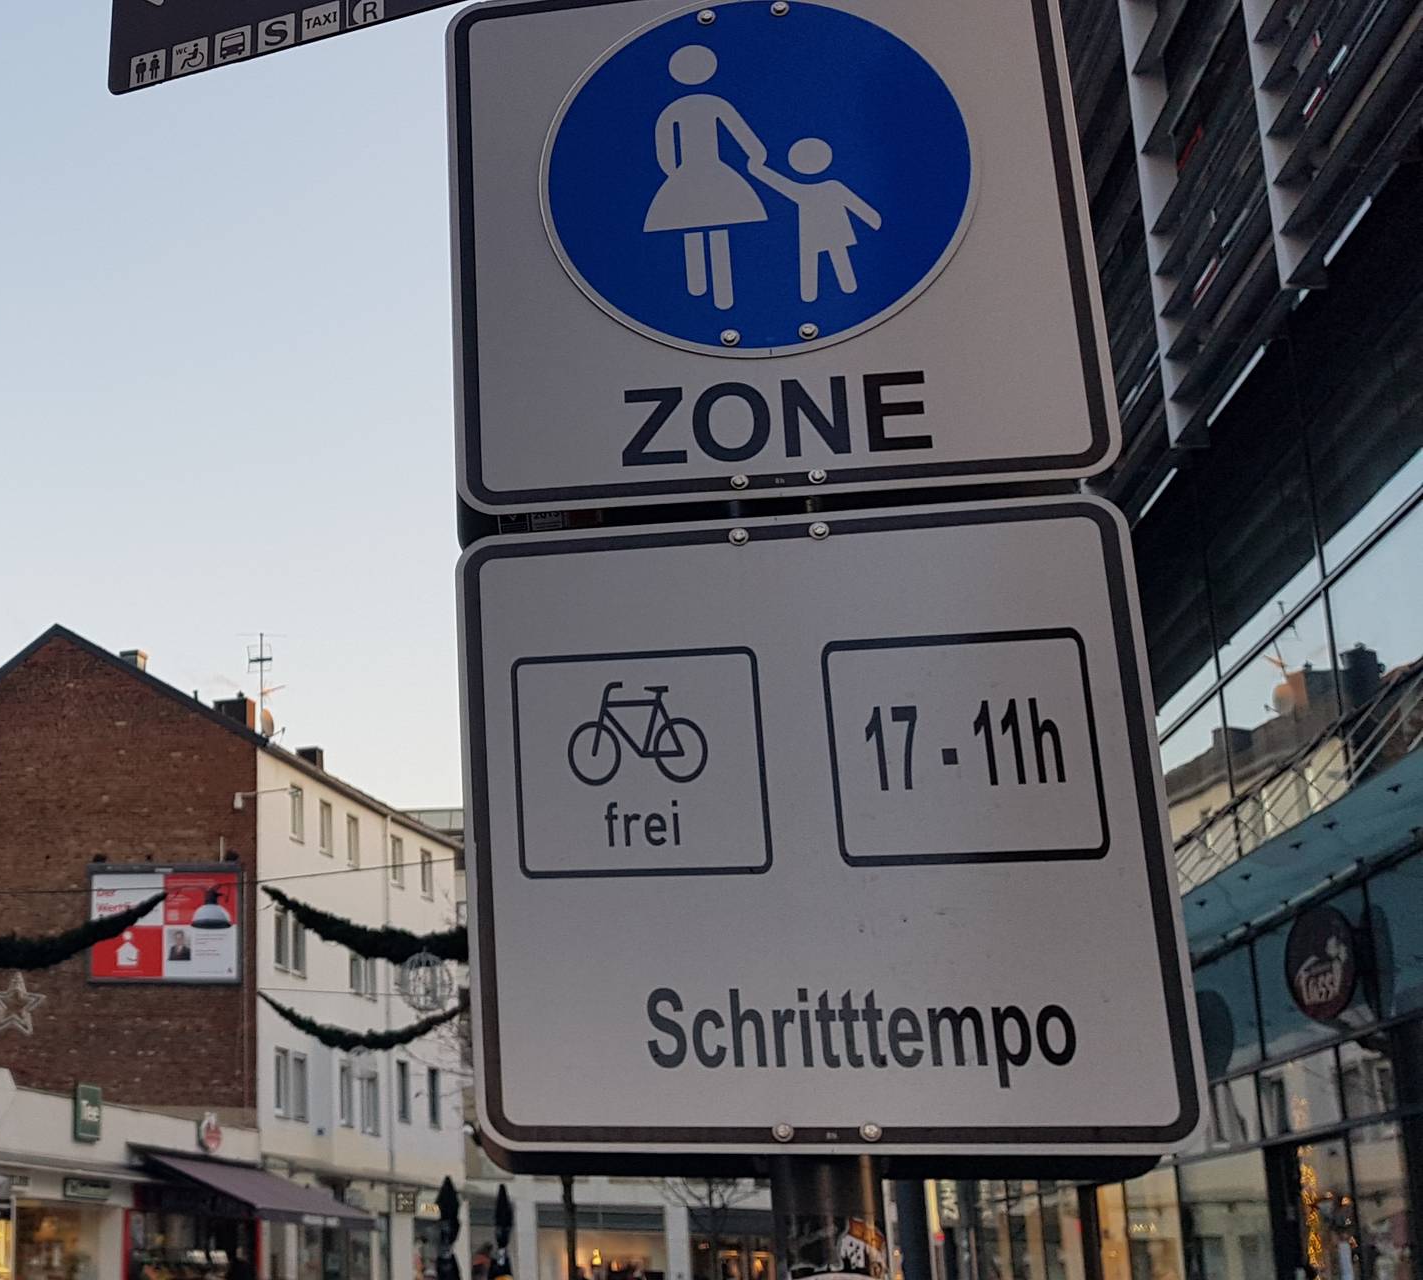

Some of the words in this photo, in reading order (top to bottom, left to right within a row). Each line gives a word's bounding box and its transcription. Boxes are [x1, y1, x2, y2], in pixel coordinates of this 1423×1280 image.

[264, 20, 288, 46] S
[305, 12, 337, 30] TAXI
[176, 46, 189, 56] WC
[622, 371, 933, 467] ZONE
[865, 705, 917, 791] 17
[974, 698, 1066, 785] 11h
[605, 800, 680, 847] frei
[646, 988, 1077, 1088] Schritttempo
